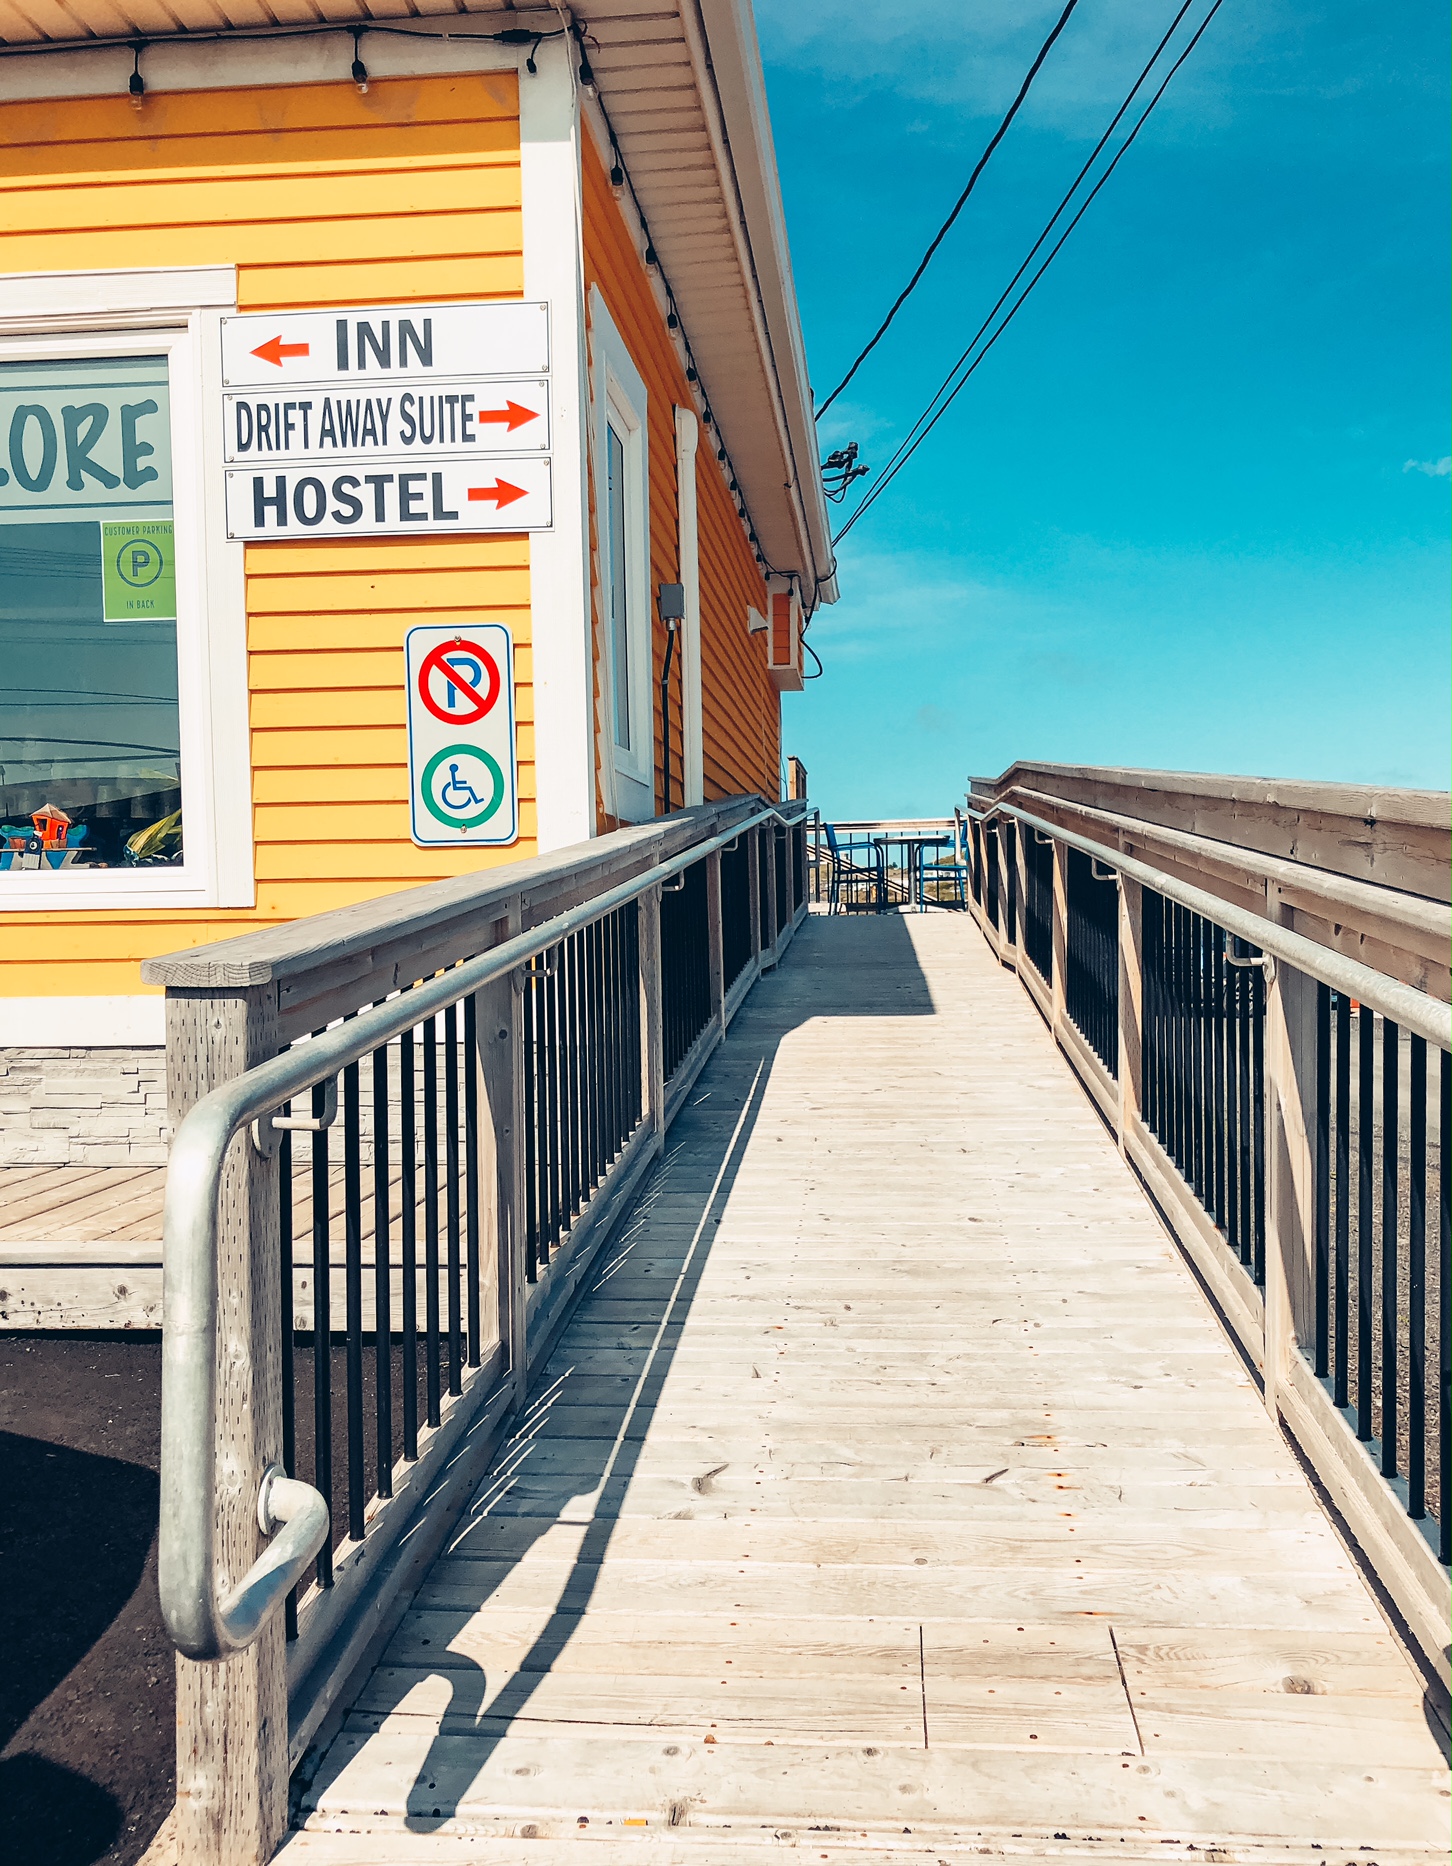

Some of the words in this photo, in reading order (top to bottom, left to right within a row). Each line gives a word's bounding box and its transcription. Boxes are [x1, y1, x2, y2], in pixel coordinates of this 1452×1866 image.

[336, 318, 433, 371] INN
[0, 399, 159, 493] ORE
[236, 401, 313, 453] DRIFT
[319, 397, 393, 449] AWAY
[399, 392, 476, 446] SUITE
[252, 472, 459, 528] HOSTEL
[104, 526, 140, 536] CUSTOMER
[142, 525, 173, 535] PARKING
[132, 550, 150, 577] P
[127, 600, 134, 609] IN
[137, 600, 155, 609] BACK
